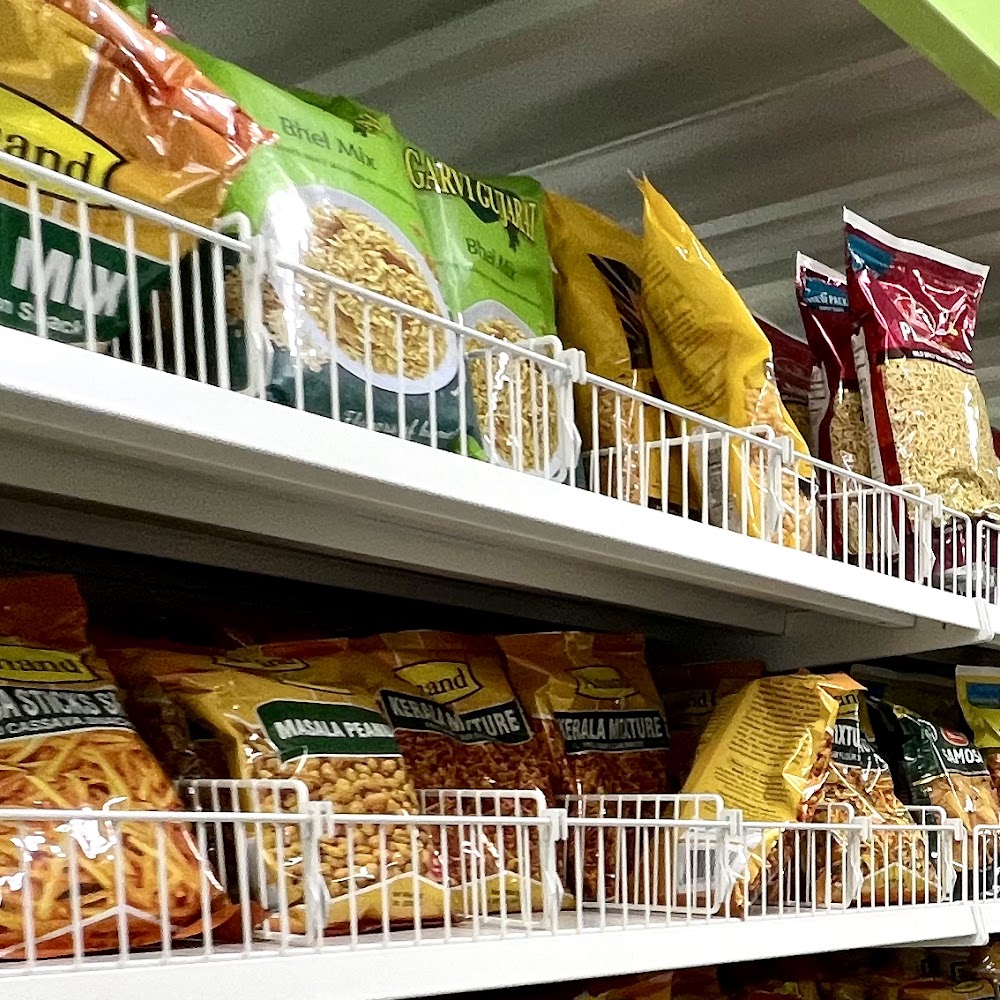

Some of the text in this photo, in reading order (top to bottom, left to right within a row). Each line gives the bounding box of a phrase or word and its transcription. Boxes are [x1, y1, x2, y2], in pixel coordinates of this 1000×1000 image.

[279, 116, 330, 150] Bhel
[336, 138, 377, 170] Mix
[403, 148, 537, 243] GARVI GUJARAT
[22, 689, 99, 716] STICKS
[274, 718, 346, 739] MASALA
[608, 716, 664, 740] MIXTURE
